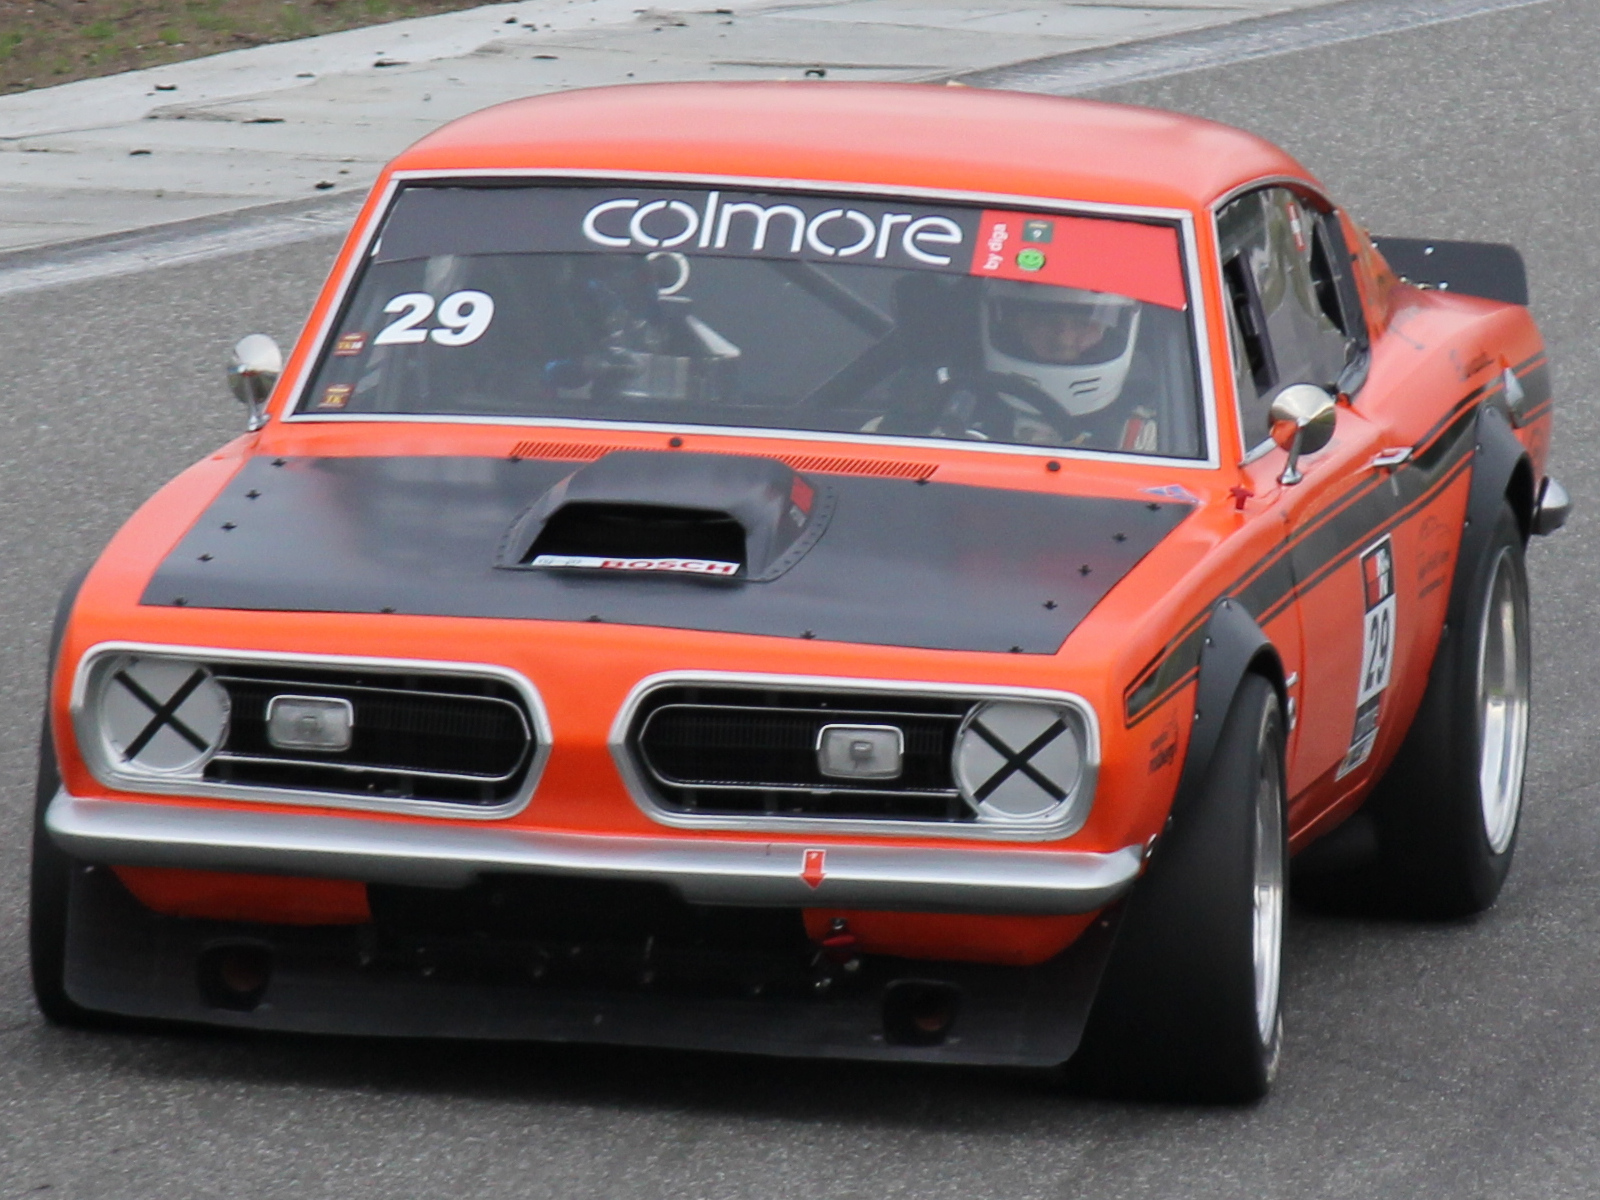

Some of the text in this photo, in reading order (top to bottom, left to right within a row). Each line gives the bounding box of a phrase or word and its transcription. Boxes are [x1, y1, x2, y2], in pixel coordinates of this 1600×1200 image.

[583, 191, 963, 265] colmore
[983, 223, 1009, 270] by diga
[374, 290, 494, 346] 29
[601, 559, 732, 575] BOSCH
[1364, 607, 1390, 692] 29
